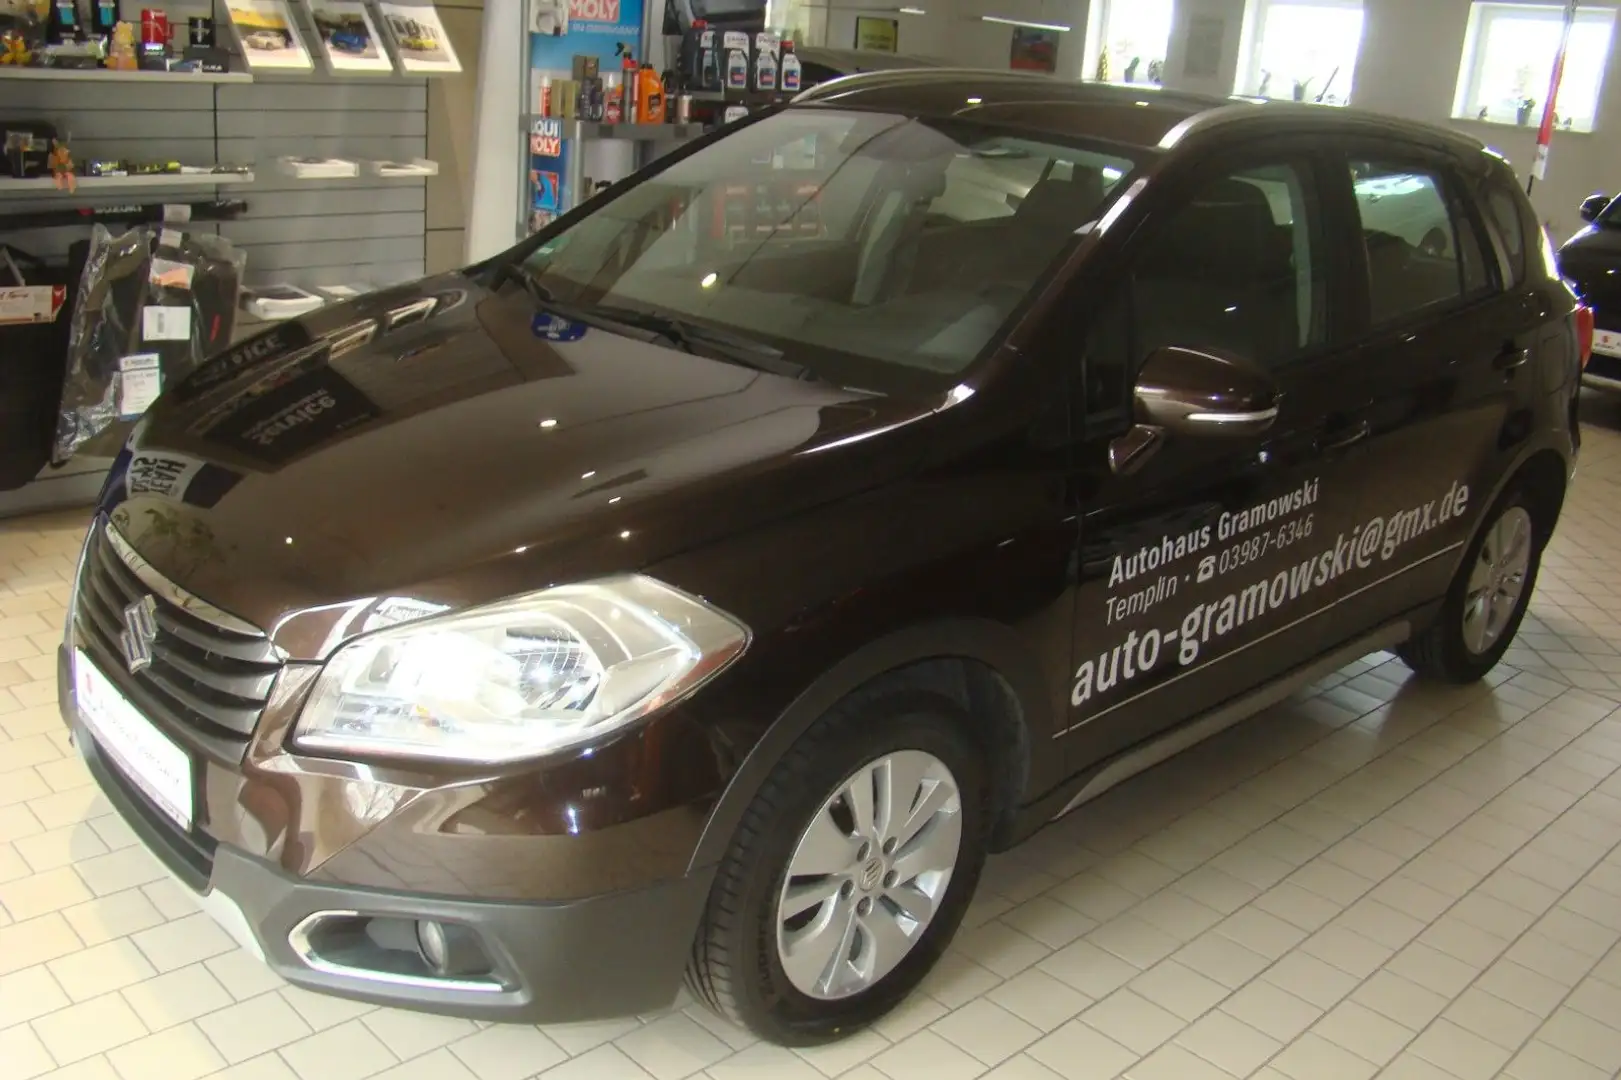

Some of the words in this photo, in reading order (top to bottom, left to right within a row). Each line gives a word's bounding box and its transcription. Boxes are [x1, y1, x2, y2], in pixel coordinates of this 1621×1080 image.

[1105, 574, 1179, 626] Templin
[1218, 513, 1315, 576] 03987-6346
[1108, 524, 1211, 589] Autohaus
[1217, 476, 1320, 542] Gramowski
[1071, 480, 1470, 707] auto-gramowski@gmx.de
